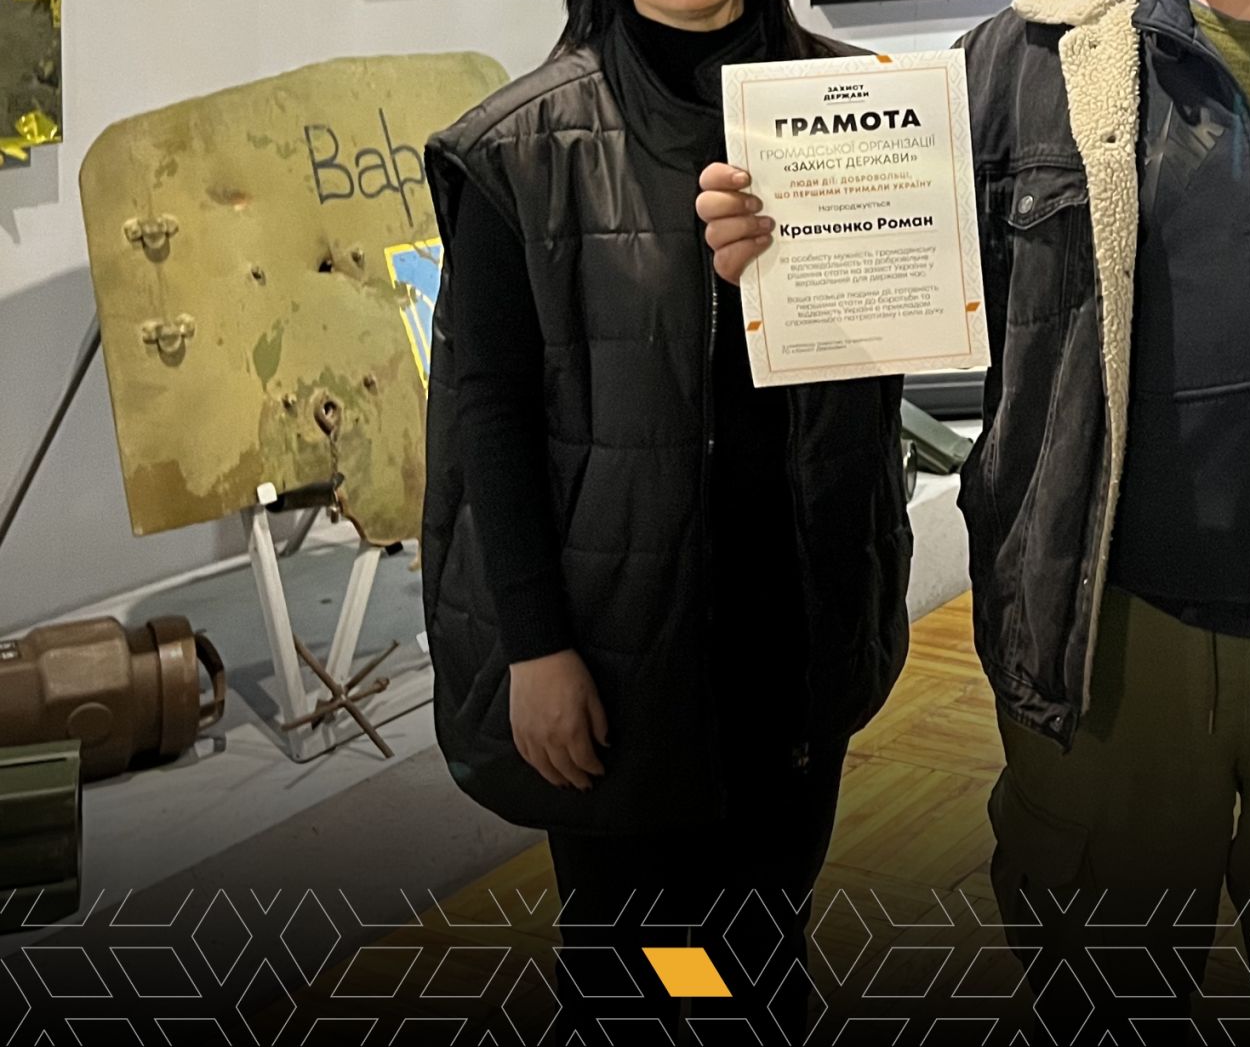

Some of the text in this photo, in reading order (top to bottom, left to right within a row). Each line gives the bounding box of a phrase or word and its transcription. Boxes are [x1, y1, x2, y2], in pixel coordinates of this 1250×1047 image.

[823, 92, 869, 101] ДЕРЖАВИ
[828, 84, 863, 92] ЗАХИСТ
[775, 109, 921, 138] ГРАМОТА
[760, 134, 936, 161] ГРОМАДСЬКОЇ ОРГАНІЗАЦІЇ
[784, 152, 918, 172] «ЗАХИСТ ДЕРЖАВИ»
[774, 180, 932, 200] ЩО ПЕРШИМИ ТРИМАЛИ УКРАЇНУ
[790, 180, 819, 188] ЛЮДИ
[818, 201, 891, 212] Нагороджується
[780, 216, 933, 238] Кравченко Роман
